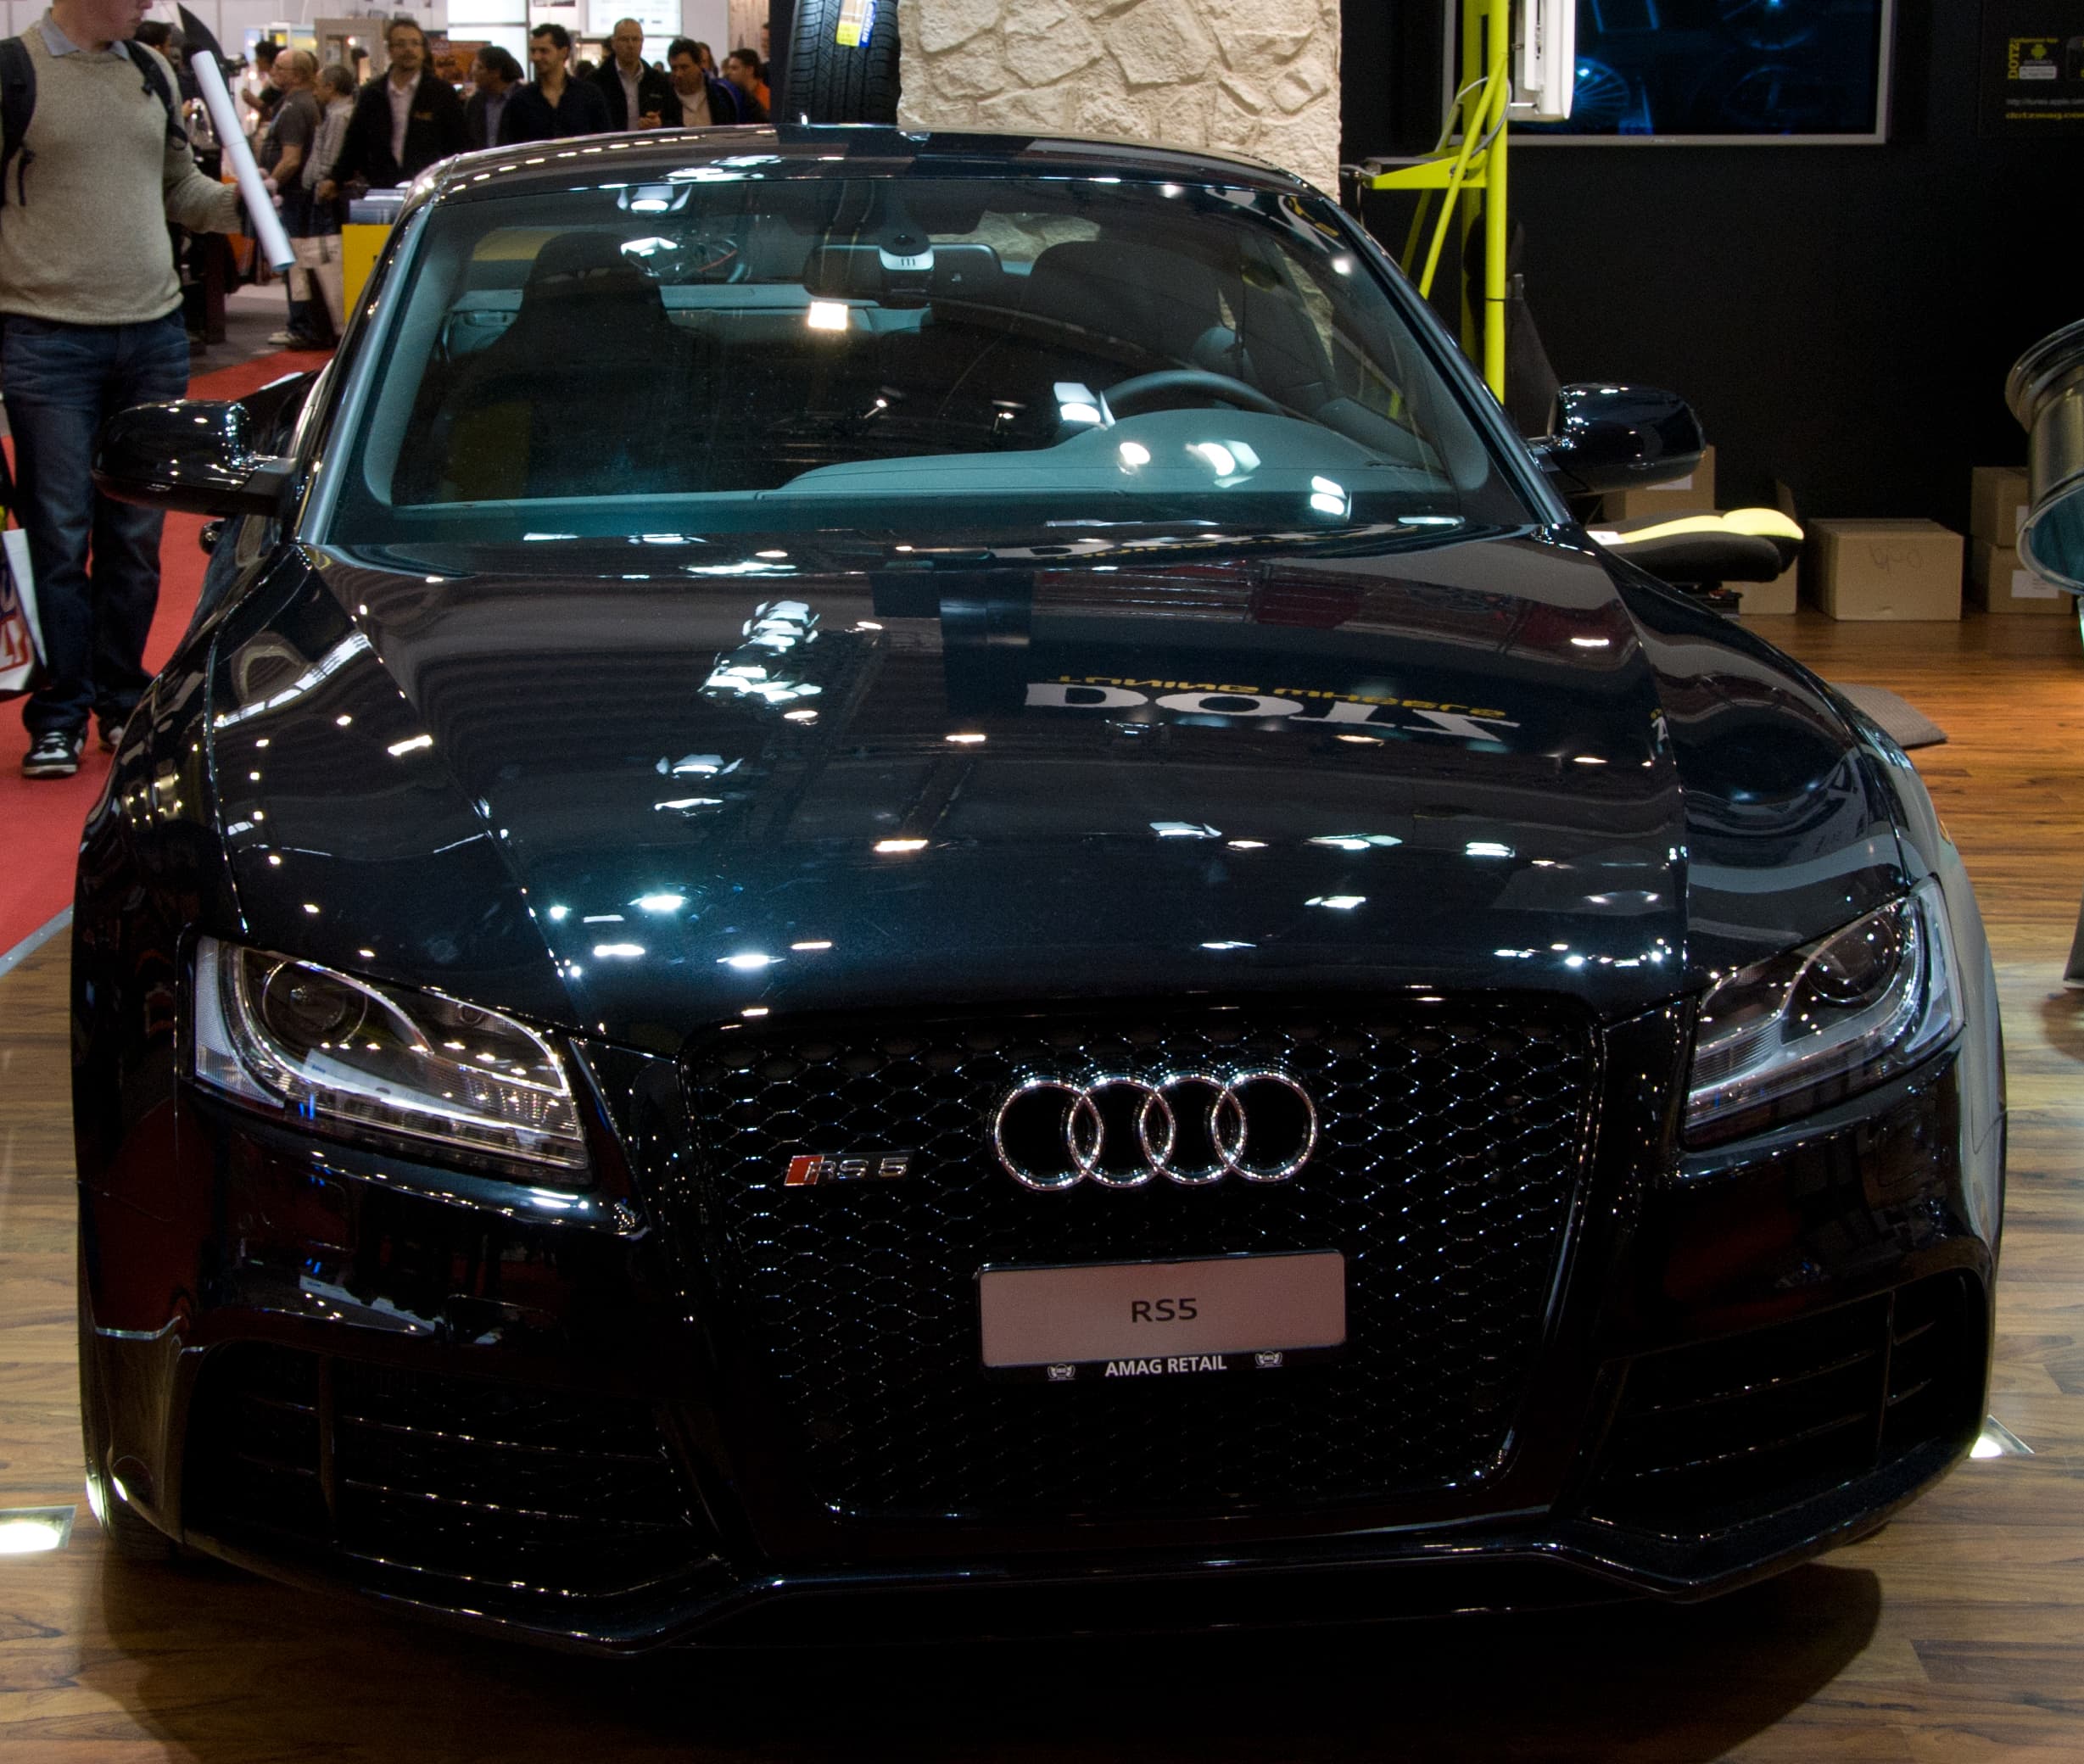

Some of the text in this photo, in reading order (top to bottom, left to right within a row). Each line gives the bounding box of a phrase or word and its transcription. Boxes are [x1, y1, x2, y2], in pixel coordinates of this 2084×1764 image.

[1131, 1298, 1198, 1323] RS5
[1105, 1355, 1227, 1377] AMAG RETAIL
